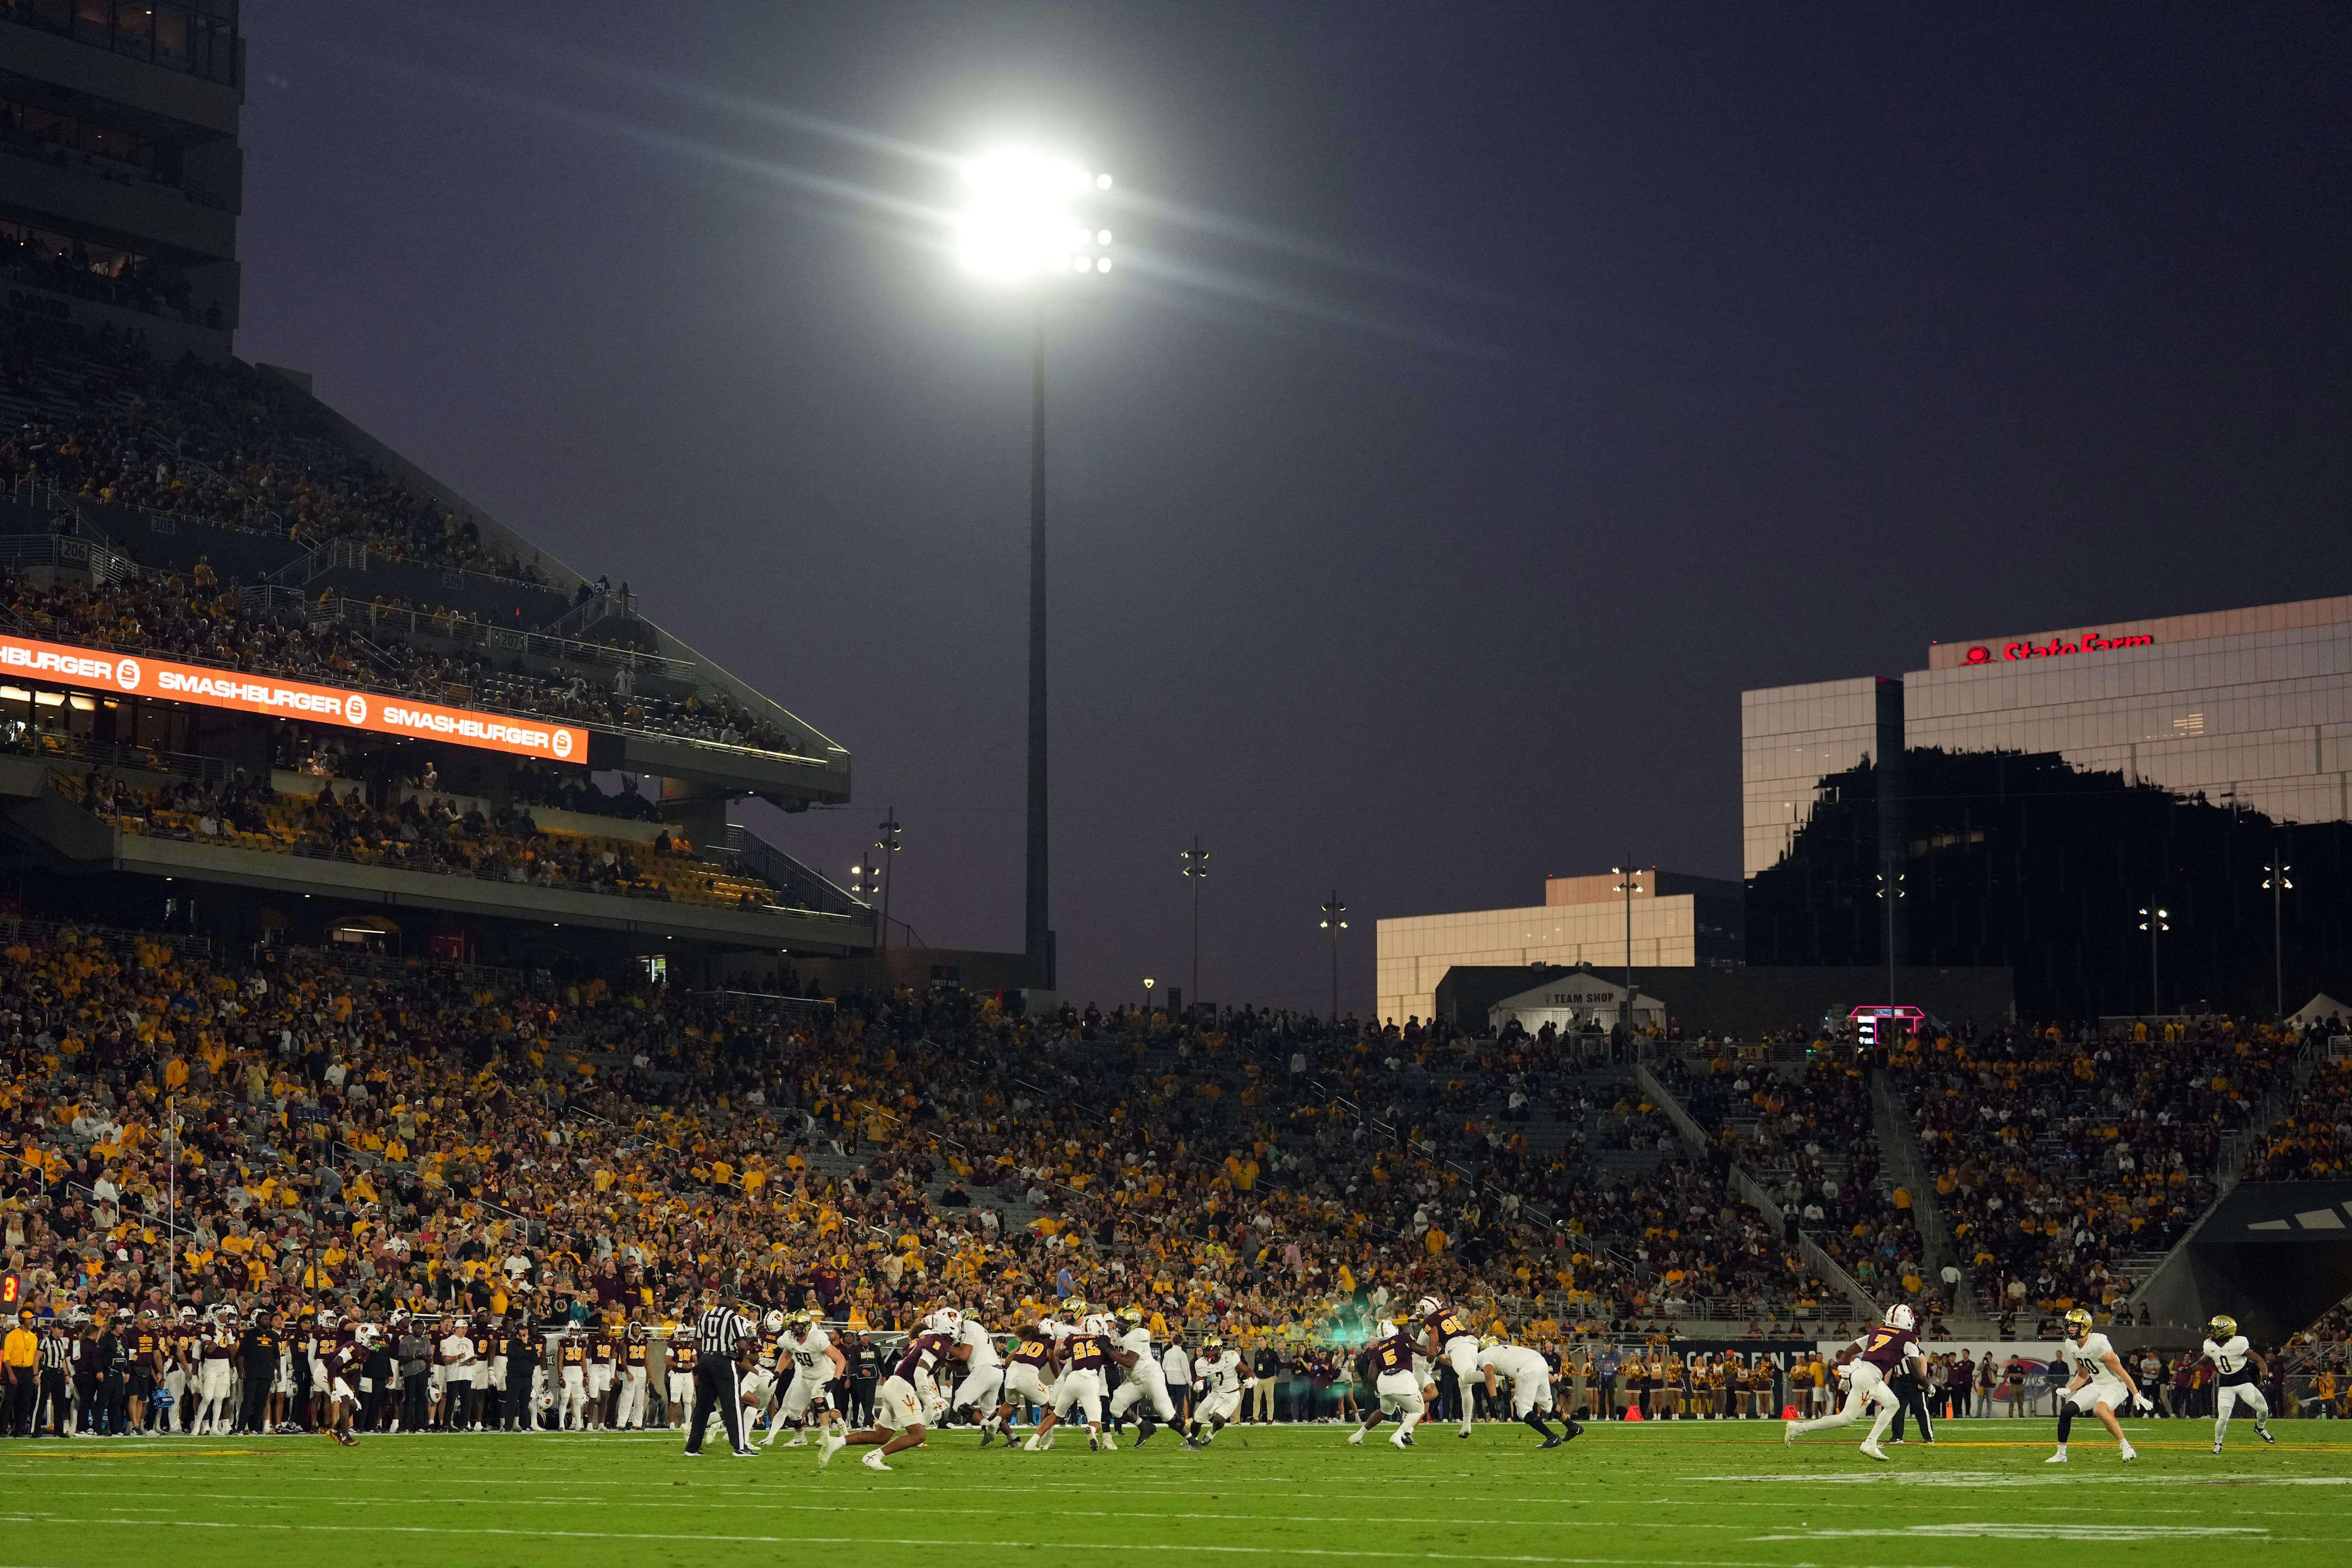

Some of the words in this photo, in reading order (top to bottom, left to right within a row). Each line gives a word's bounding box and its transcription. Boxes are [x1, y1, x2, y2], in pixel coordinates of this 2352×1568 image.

[153, 517, 173, 533] 308
[64, 542, 86, 559] 206
[445, 575, 461, 588] 309
[502, 634, 519, 649] 207
[158, 671, 341, 715] SMASHBURGER
[383, 706, 549, 748] SMASHBURGER
[1554, 994, 1583, 1004] TEAM
[1586, 993, 1614, 1003] SHOP
[3, 1276, 16, 1302] 3
[707, 1316, 720, 1337] U
[1441, 1315, 1466, 1335] 95
[932, 1341, 942, 1350] 2
[1015, 1338, 1045, 1358] 30
[1868, 1334, 1893, 1352] 7
[677, 1349, 691, 1361] 19
[795, 1352, 814, 1367] 69
[1382, 1348, 1397, 1366] 5
[2220, 1356, 2232, 1373] 0
[1215, 1371, 1224, 1386] 7
[1633, 1407, 1643, 1419] 10
[1789, 1406, 1798, 1418] G
